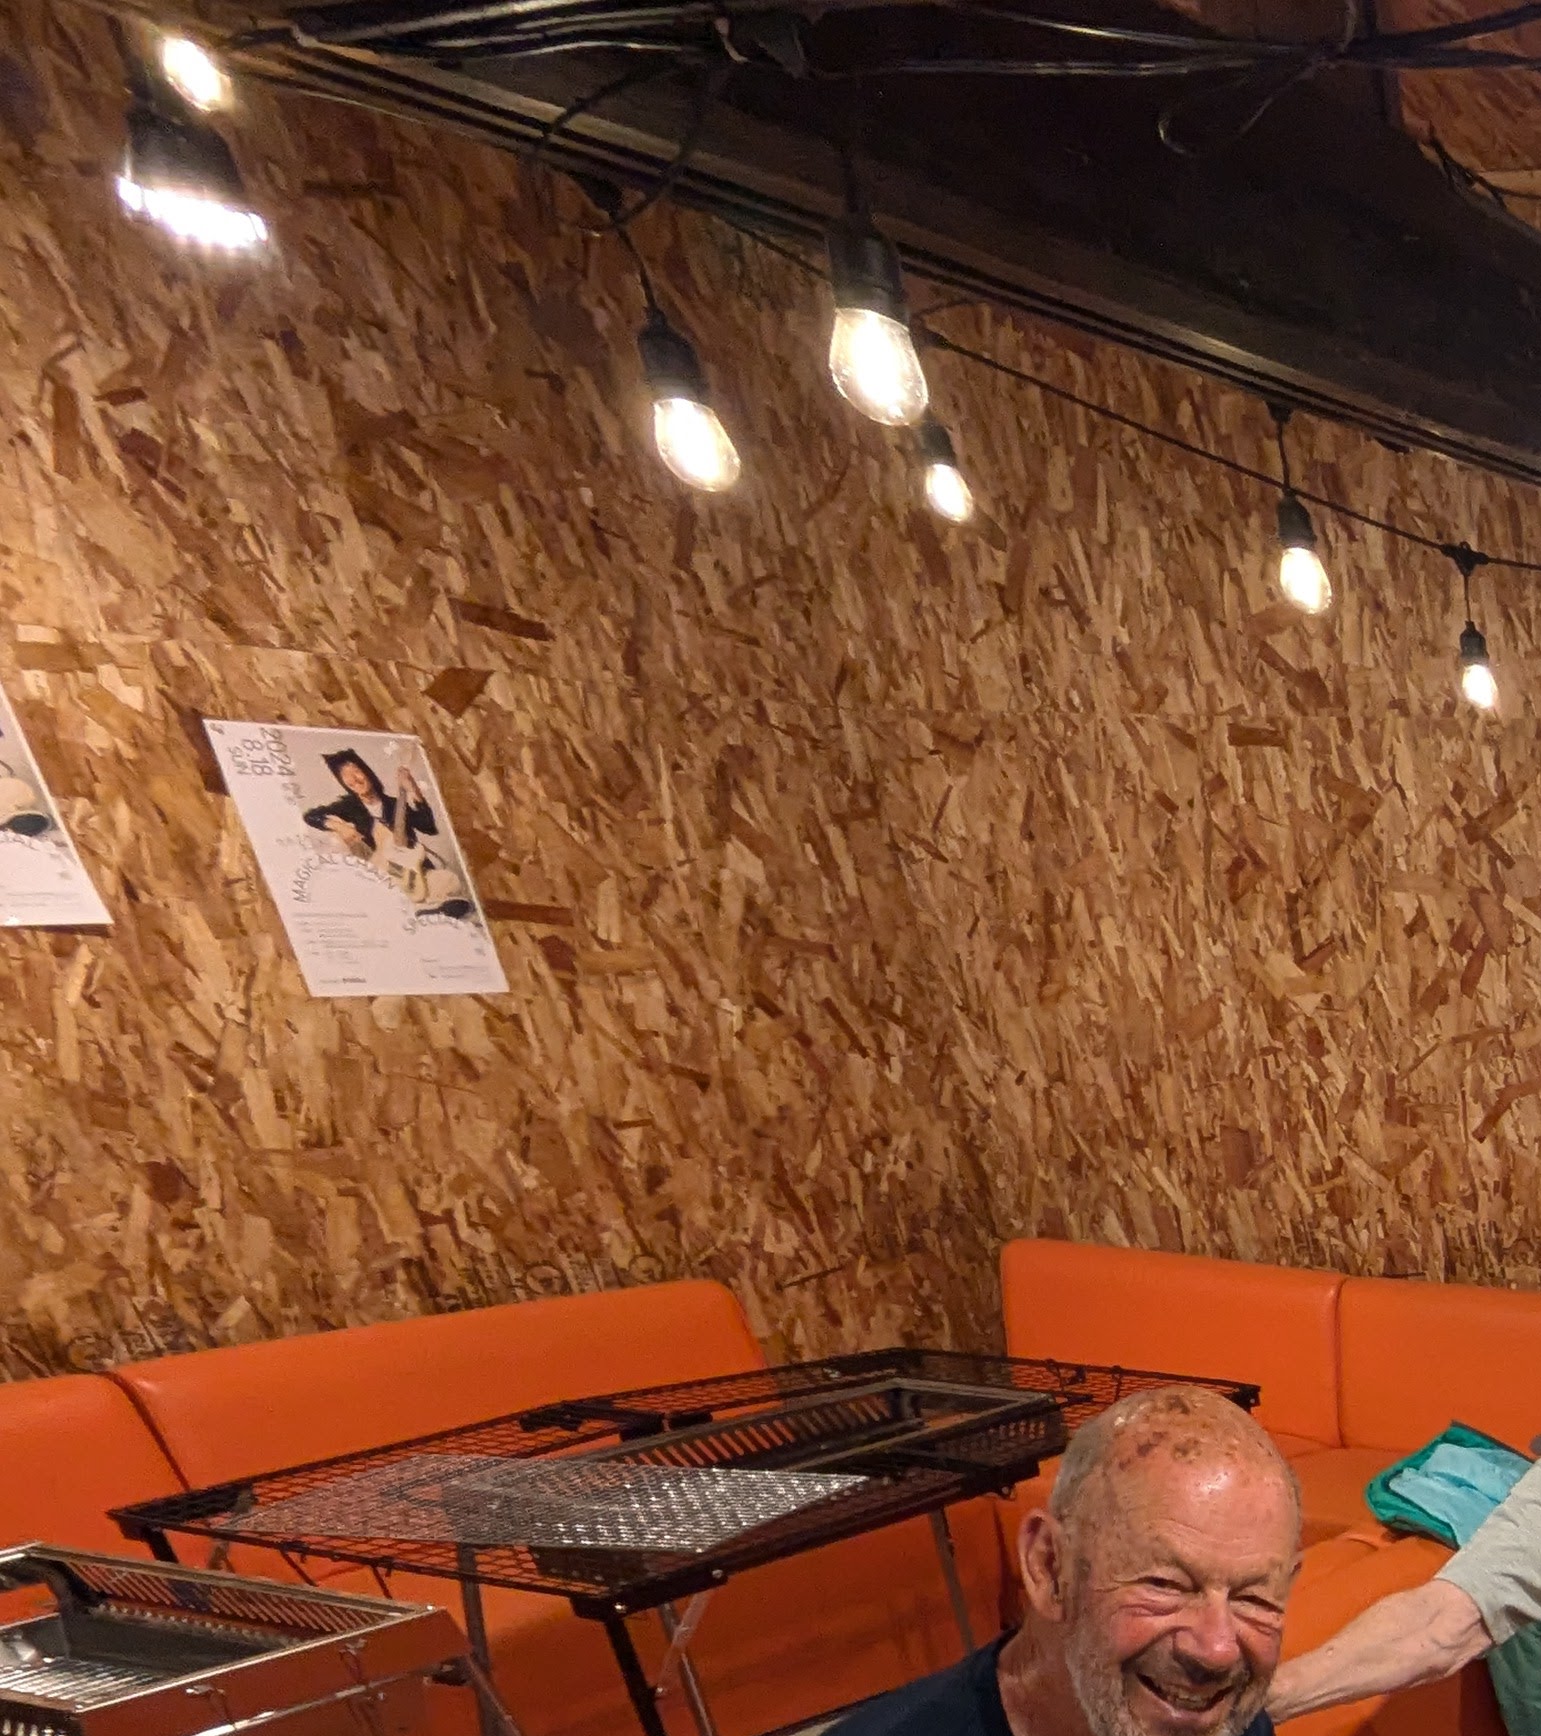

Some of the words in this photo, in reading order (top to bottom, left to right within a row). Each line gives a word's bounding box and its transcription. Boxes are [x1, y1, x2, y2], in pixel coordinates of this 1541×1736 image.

[227, 745, 252, 775] SUN
[242, 738, 273, 776] 8.18
[259, 727, 296, 777] 2024
[292, 852, 339, 903] MAGICAL
